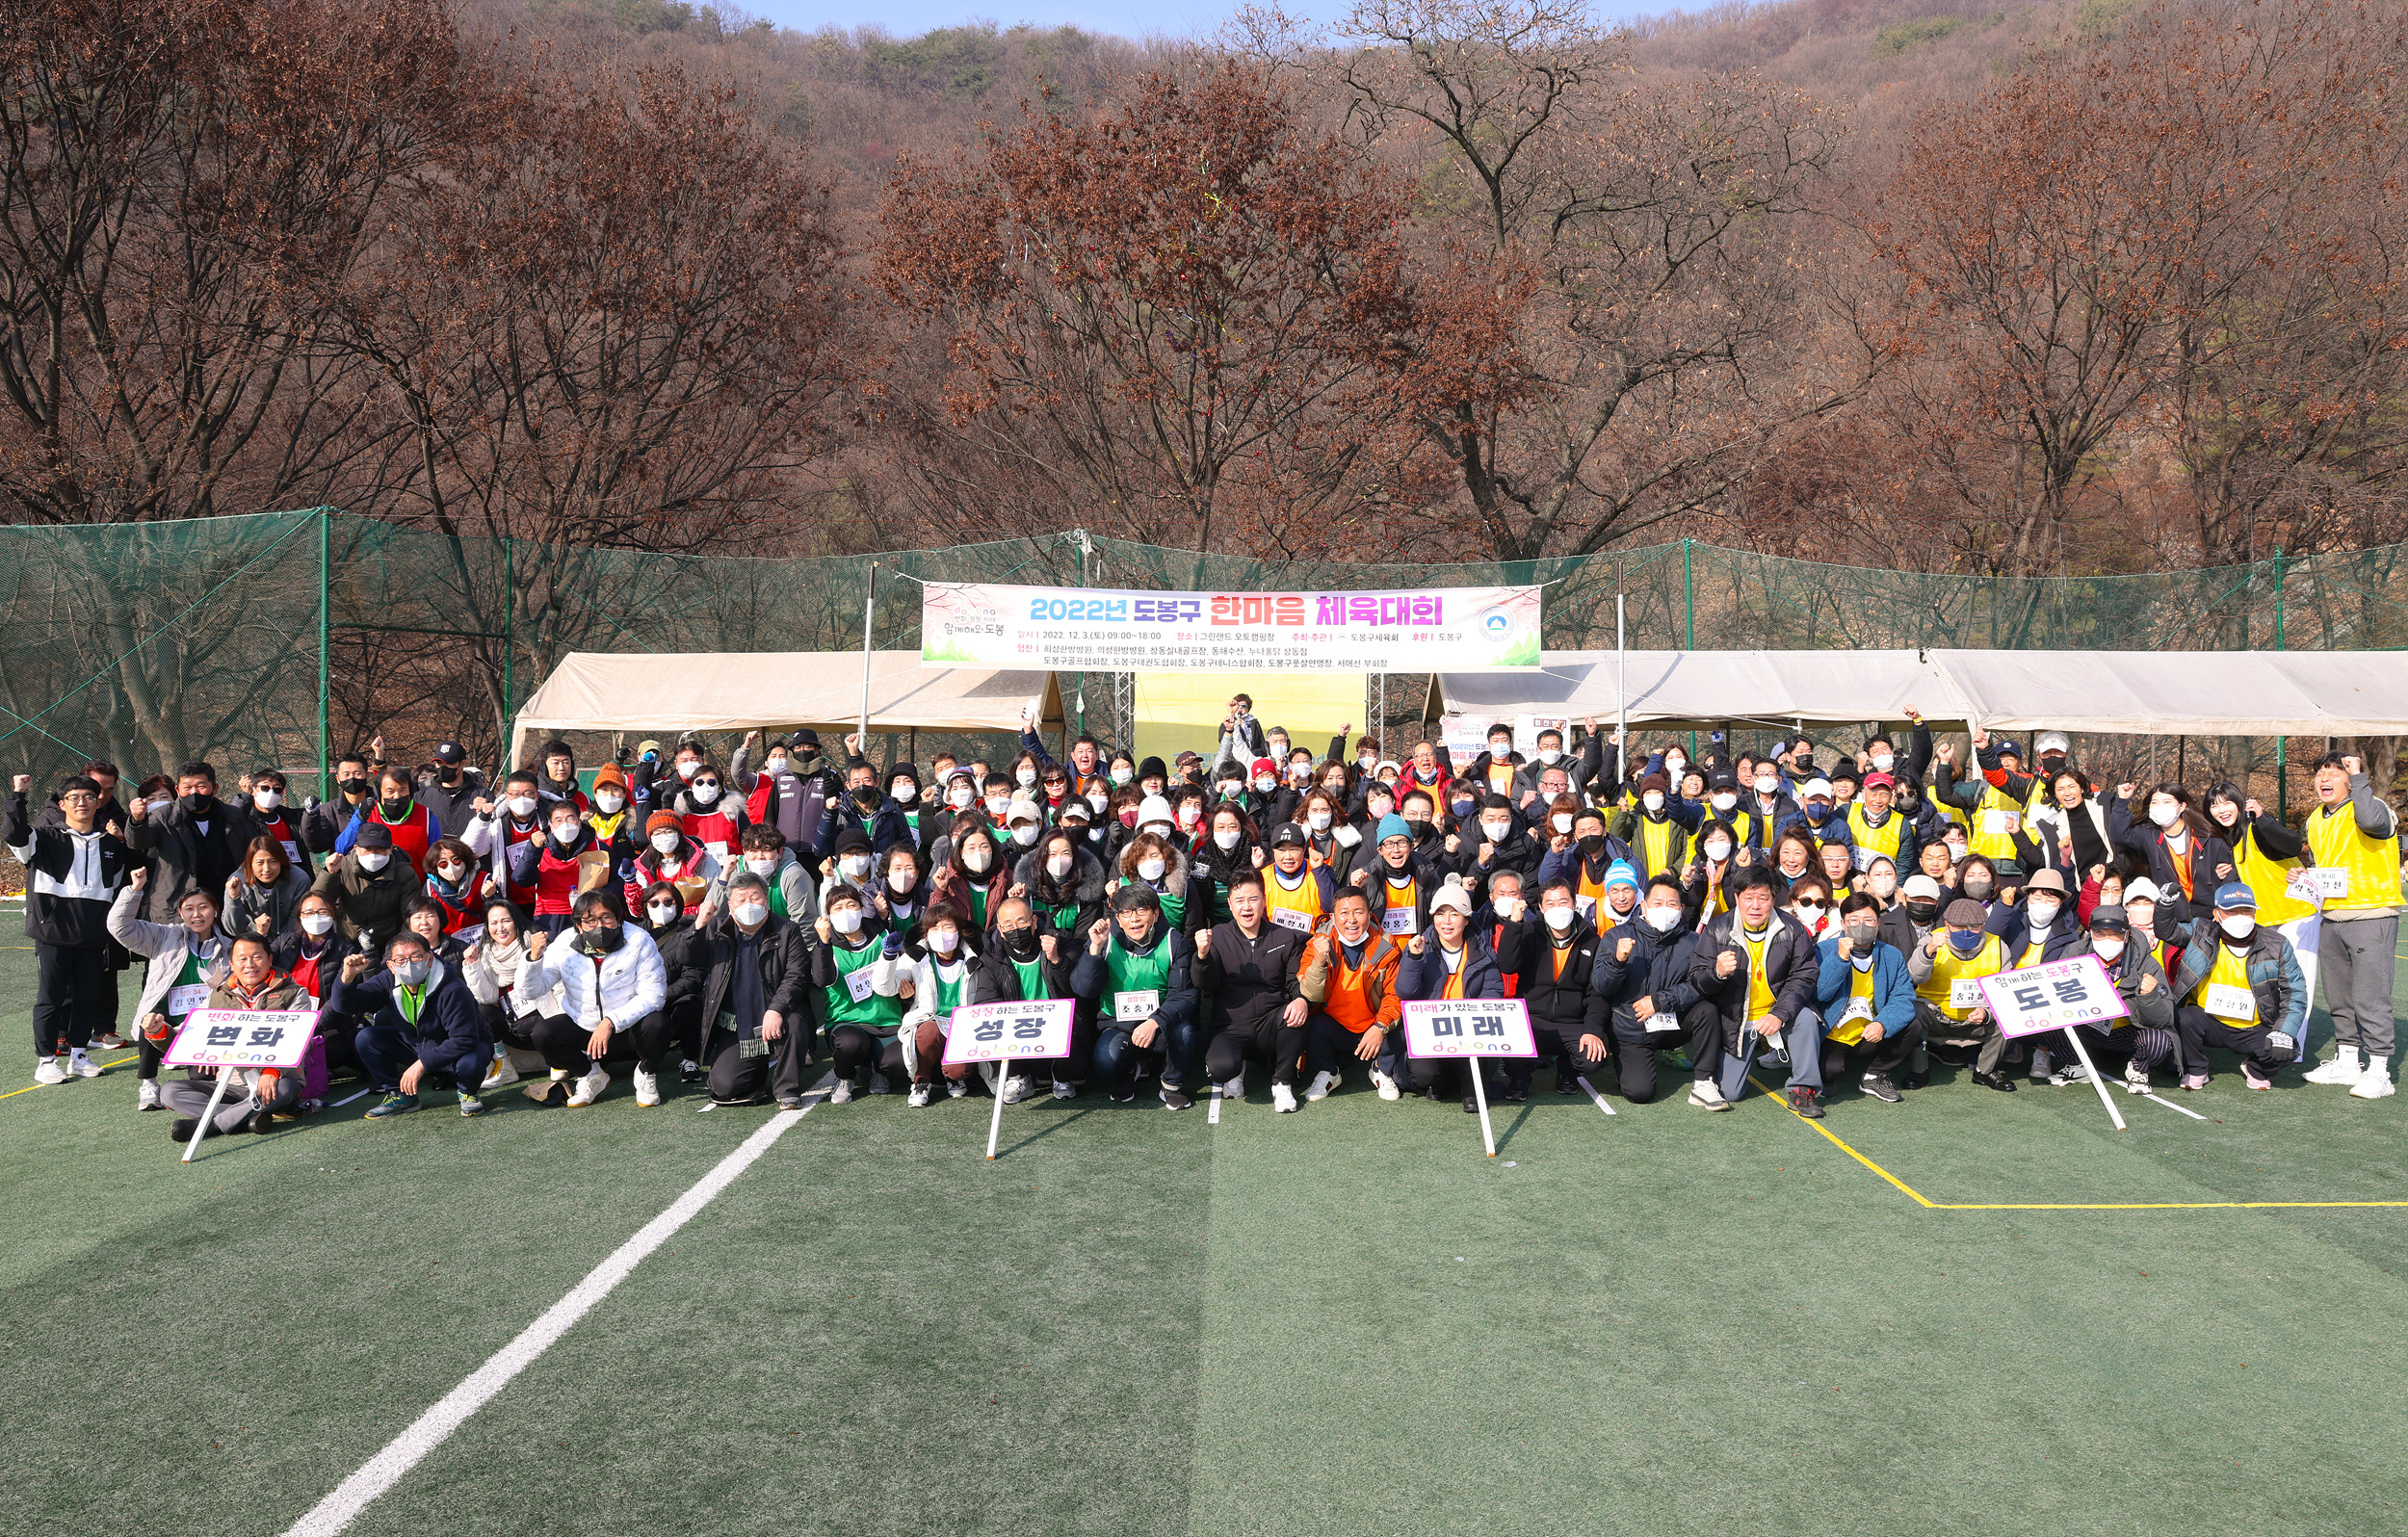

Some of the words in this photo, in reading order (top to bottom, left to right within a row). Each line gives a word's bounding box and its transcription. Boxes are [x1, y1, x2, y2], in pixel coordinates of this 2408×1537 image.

[1030, 598, 1127, 622] 2022년
[1134, 599, 1201, 623] 도봉구
[1211, 595, 1305, 626] 한마음
[1316, 596, 1443, 627] 체육대회
[1017, 630, 1034, 638] 일시
[1043, 631, 1065, 639] 2022.
[1068, 631, 1081, 639] 12.
[1176, 632, 1193, 640] 장소
[1199, 632, 1232, 641] 그린랜드
[1235, 633, 1275, 642] 오토캠핑장
[1292, 633, 1327, 642] 주최·주관
[1350, 633, 1400, 642] 도봉구체육회
[1412, 633, 1428, 641] 후원
[1438, 633, 1463, 641] 도봉구
[1017, 643, 1033, 653] 협찬
[1283, 647, 1308, 657] 창동점
[2046, 962, 2083, 978] 도봉구
[2013, 977, 2088, 1012] 도봉
[1022, 1003, 1056, 1013] 도봉구
[1454, 1003, 1479, 1012] 있는
[1481, 1003, 1517, 1012] 도봉구
[264, 1013, 301, 1023] 도봉구
[2025, 1006, 2104, 1028] dobong
[973, 1017, 1047, 1042] 성장
[1431, 1016, 1505, 1037] 미래
[206, 1026, 285, 1048] 변화
[967, 1043, 1045, 1057] dobong
[1432, 1040, 1511, 1055] dobong
[193, 1049, 276, 1064] dobong
